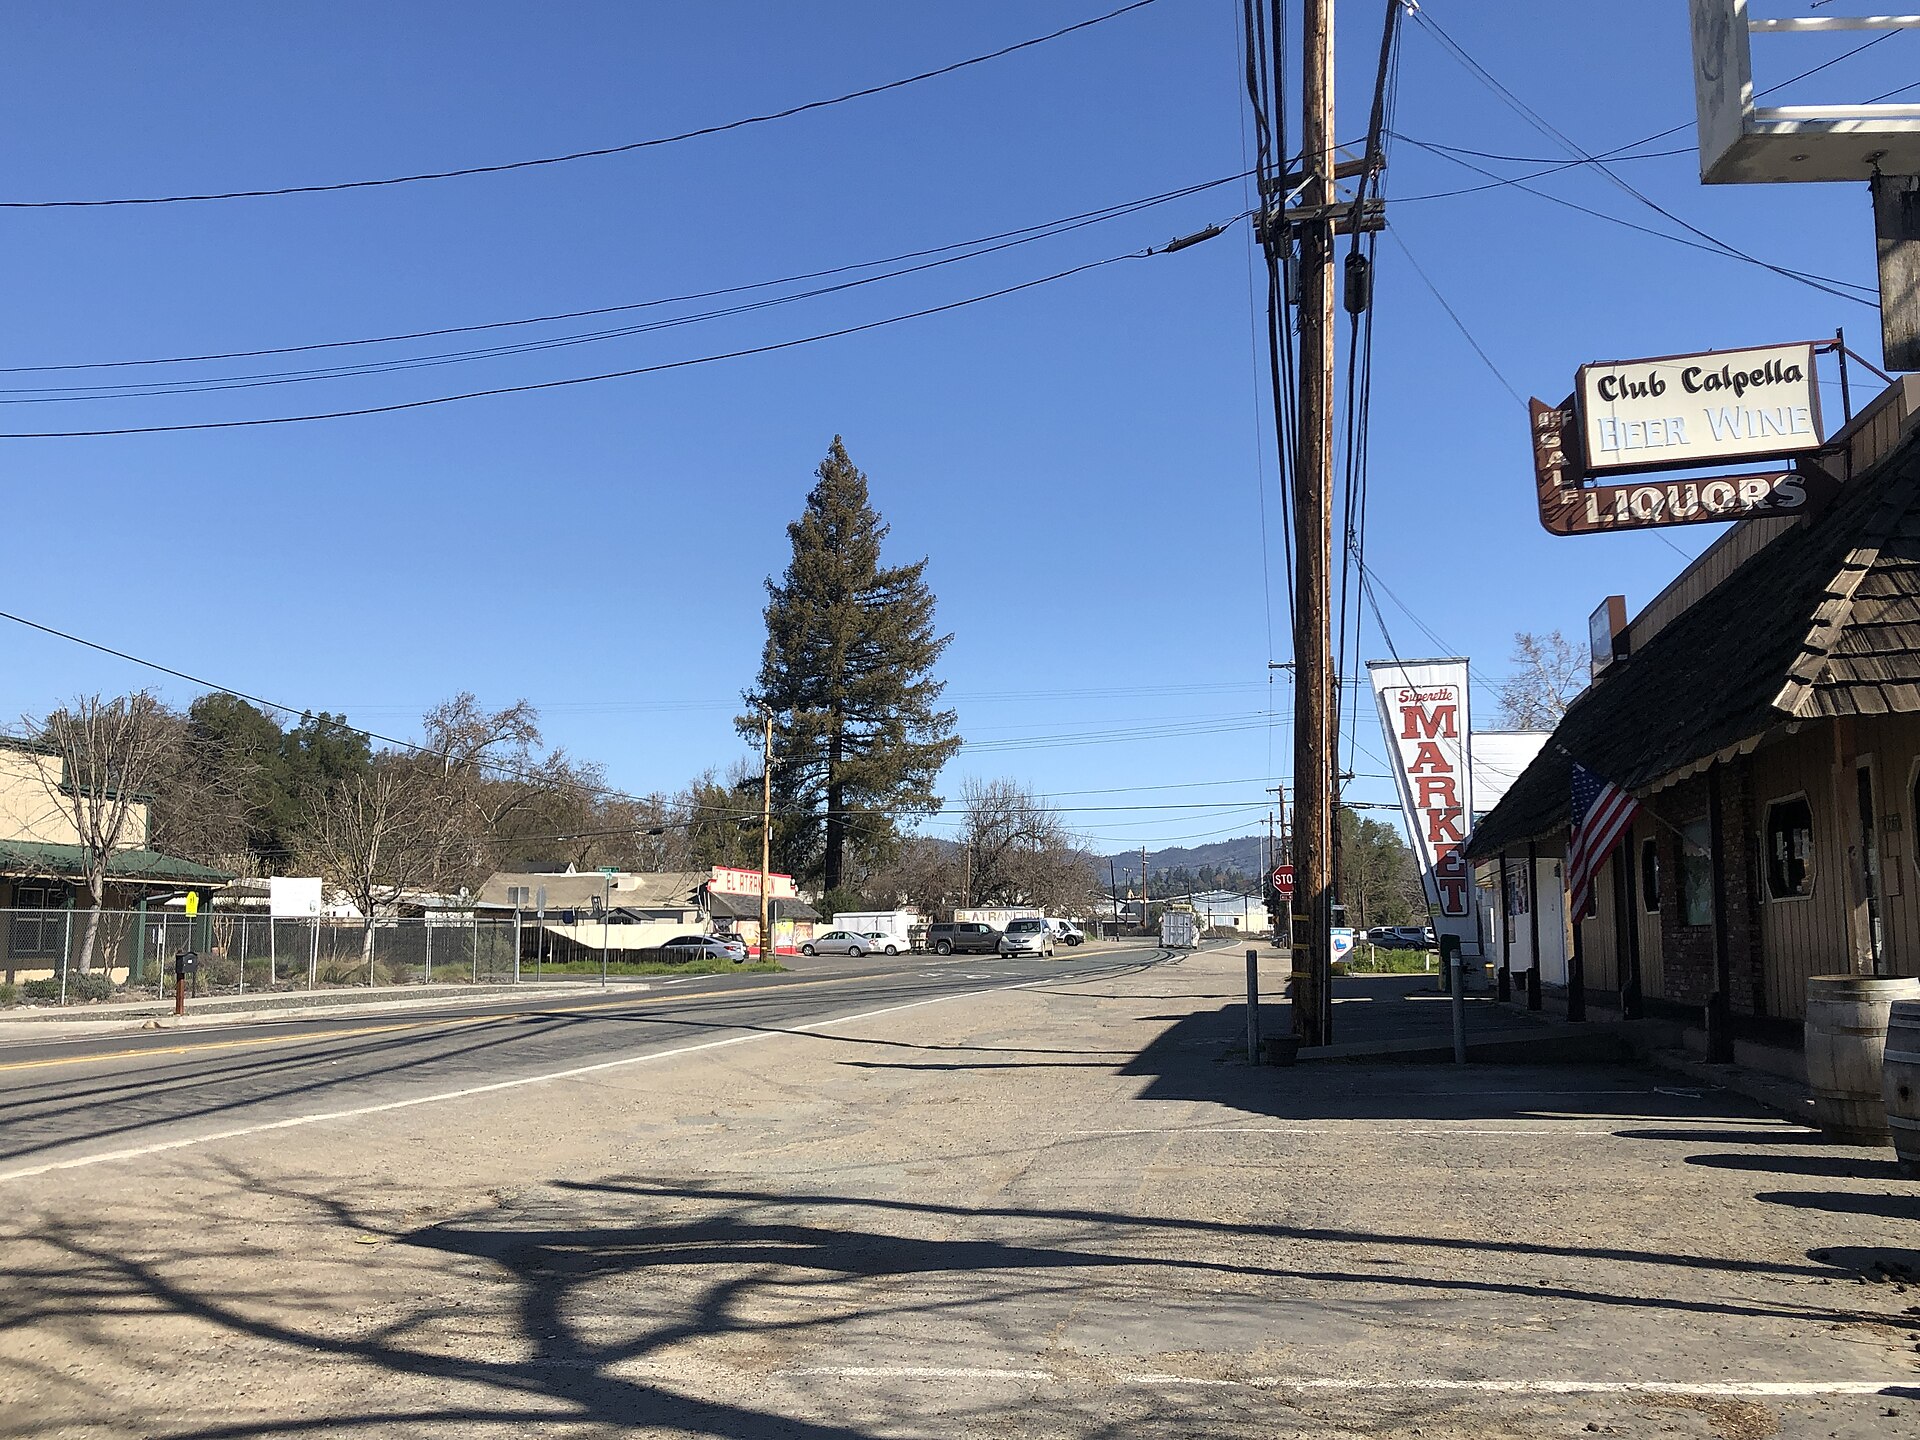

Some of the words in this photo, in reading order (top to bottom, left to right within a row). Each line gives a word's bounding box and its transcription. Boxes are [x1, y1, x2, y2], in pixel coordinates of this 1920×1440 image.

[1597, 370, 1667, 402] Club
[1681, 358, 1804, 399] Calpella
[1597, 416, 1691, 452] BEER
[1703, 405, 1811, 442] WINE
[1585, 474, 1808, 525] LIQUORS
[1398, 688, 1453, 706] Superette
[1399, 704, 1466, 913] MARKET
[726, 872, 736, 891] EL
[1275, 873, 1294, 885] STO
[956, 911, 970, 922] EL
